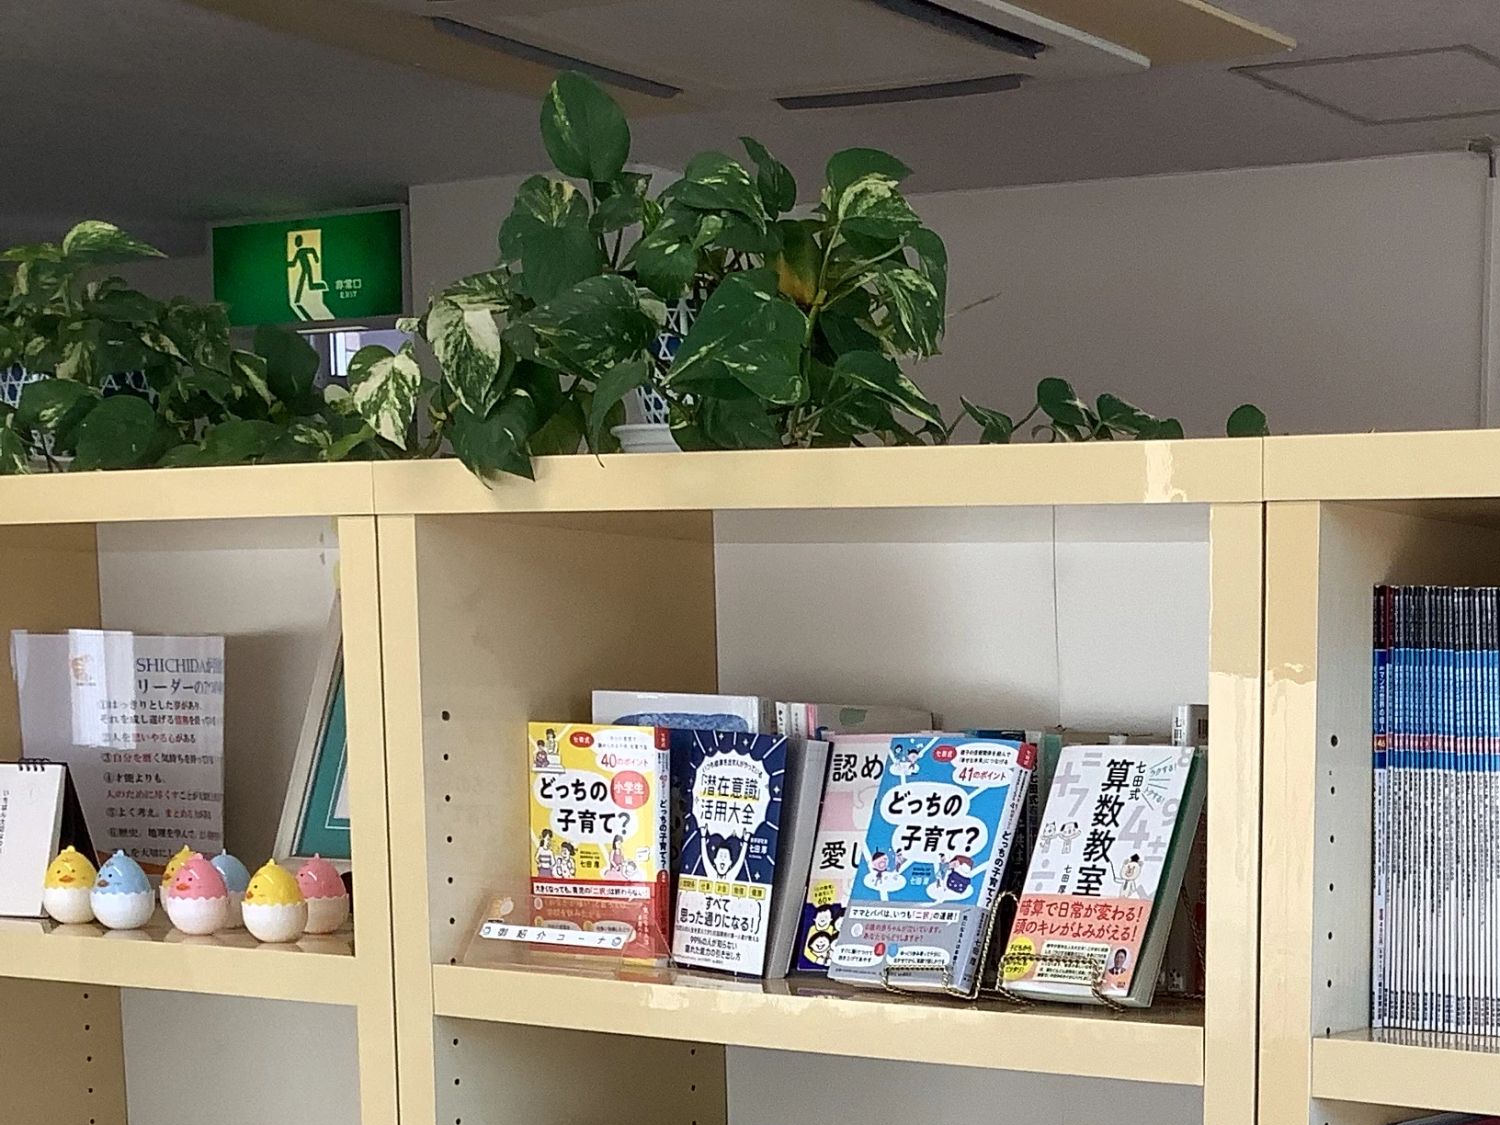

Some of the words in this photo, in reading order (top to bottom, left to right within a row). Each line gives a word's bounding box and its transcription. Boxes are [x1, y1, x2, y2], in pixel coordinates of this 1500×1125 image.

[601, 754, 649, 768] 40のポイント
[700, 774, 760, 801] 「潜在意識」
[958, 767, 1007, 782] 41のポイント
[1128, 761, 1147, 801] 七田式
[540, 777, 608, 801] どっちの
[614, 781, 645, 795] 小学生
[700, 799, 755, 825] 活用大全
[888, 790, 963, 817] どっちの
[557, 808, 631, 835] 子育て?
[1072, 758, 1135, 897] 算数教室
[658, 800, 668, 870] どっちの子育て?
[901, 825, 980, 853] 子育て?
[1057, 864, 1072, 894] 七田厚
[705, 896, 731, 912] すべて
[1019, 899, 1144, 923] 暗算で日常が変わる!
[680, 907, 756, 933] 思った通りになる!
[1013, 918, 1138, 942] 頭のキレがよみがえる!
